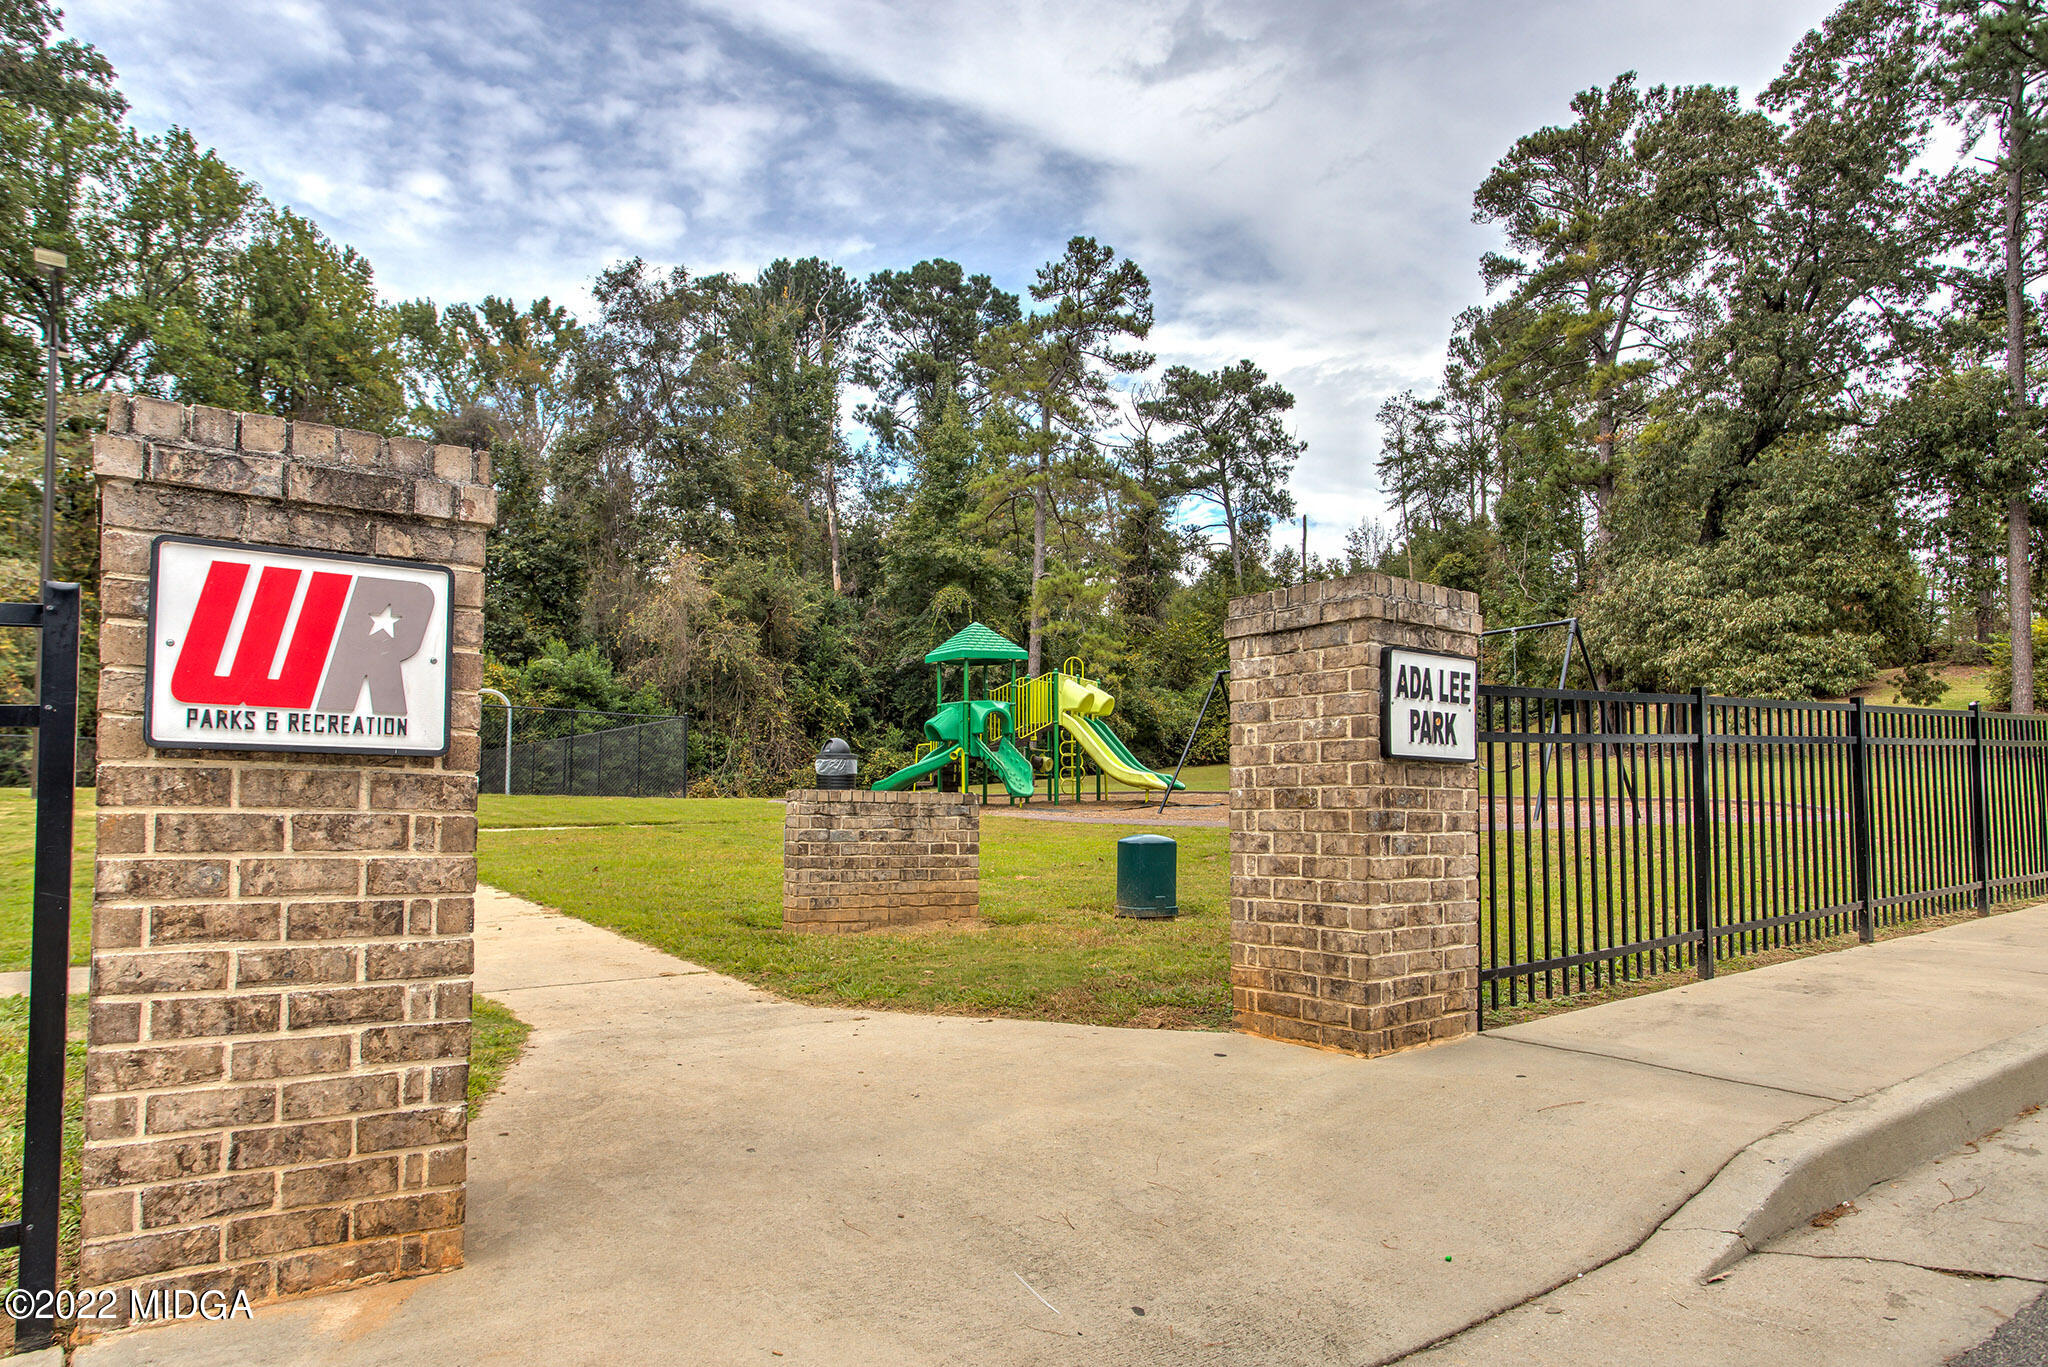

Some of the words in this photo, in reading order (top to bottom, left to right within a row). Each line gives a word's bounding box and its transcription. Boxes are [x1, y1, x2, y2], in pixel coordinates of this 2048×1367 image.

[1396, 664, 1433, 701] ADA
[1439, 669, 1471, 705] LEE
[187, 708, 256, 730] PARKS
[266, 711, 278, 732] &
[288, 713, 408, 736] RECREATION
[1409, 709, 1458, 746] PARK
